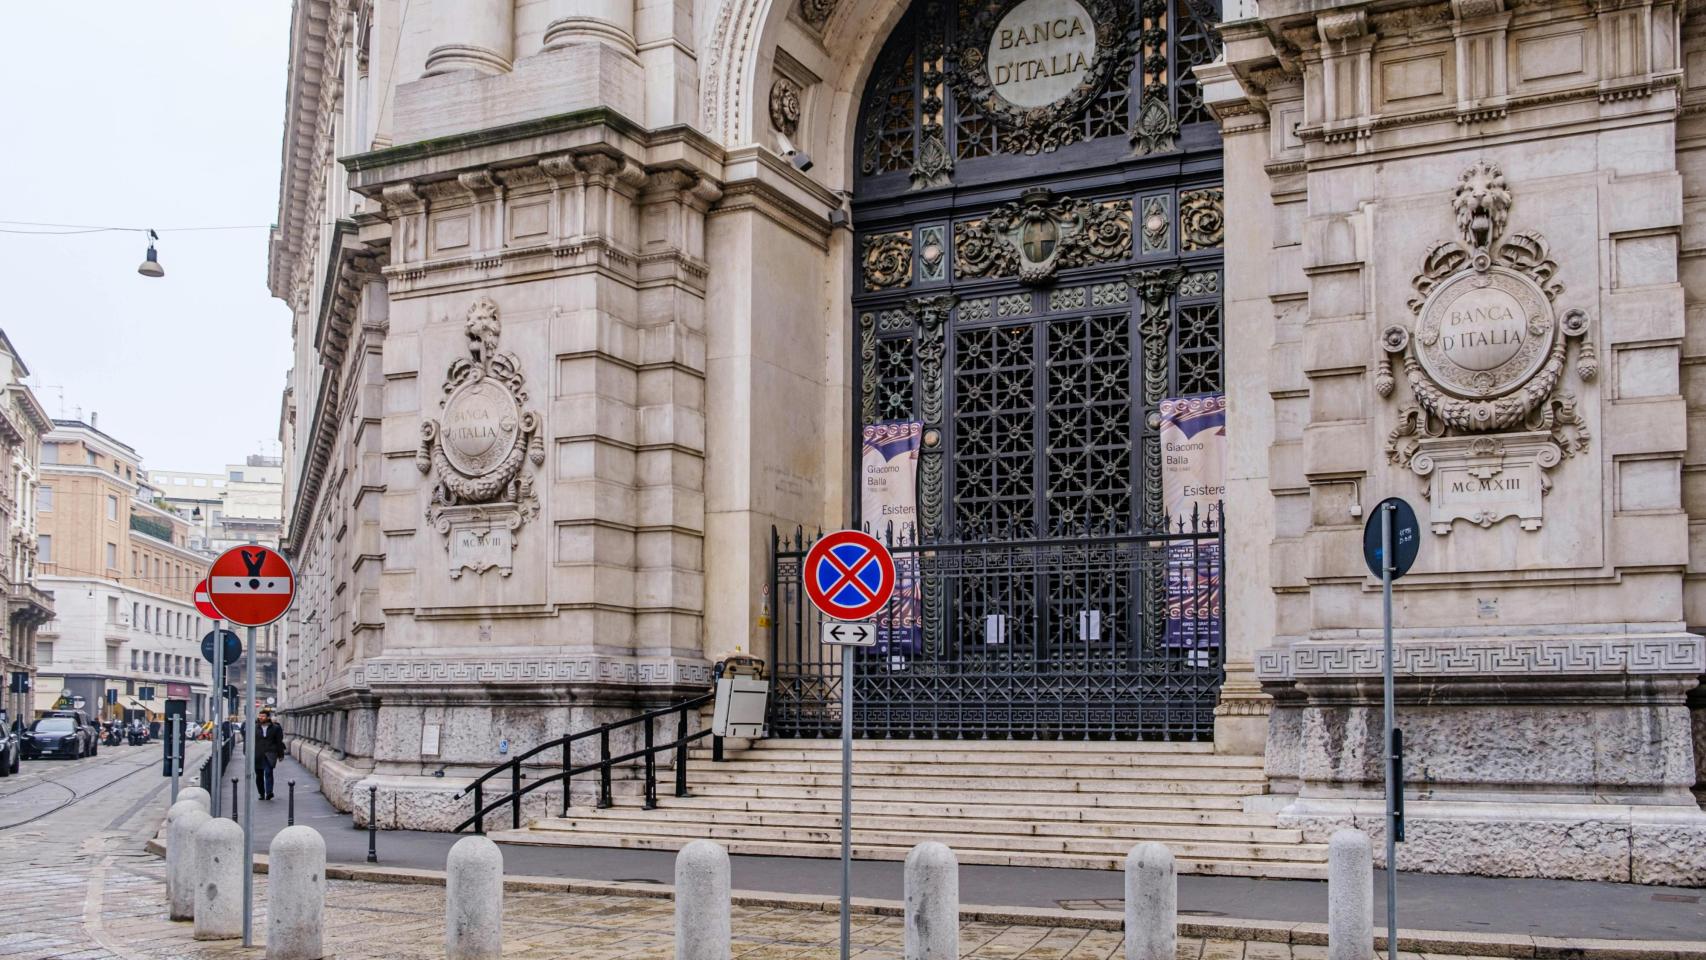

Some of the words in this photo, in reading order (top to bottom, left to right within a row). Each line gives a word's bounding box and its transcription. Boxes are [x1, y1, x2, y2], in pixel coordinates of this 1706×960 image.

[999, 16, 1086, 50] BANCA
[994, 51, 1089, 86] D'ITALIA
[1450, 305, 1514, 327] BANCA
[1442, 328, 1522, 352] D'ITALIA
[1166, 442, 1204, 452] Giacomo
[1166, 456, 1189, 465] Balla
[867, 465, 900, 474] Giacomo
[867, 477, 887, 486] Balla
[1450, 478, 1521, 493] MCMXIII
[1183, 485, 1226, 496] Esistere
